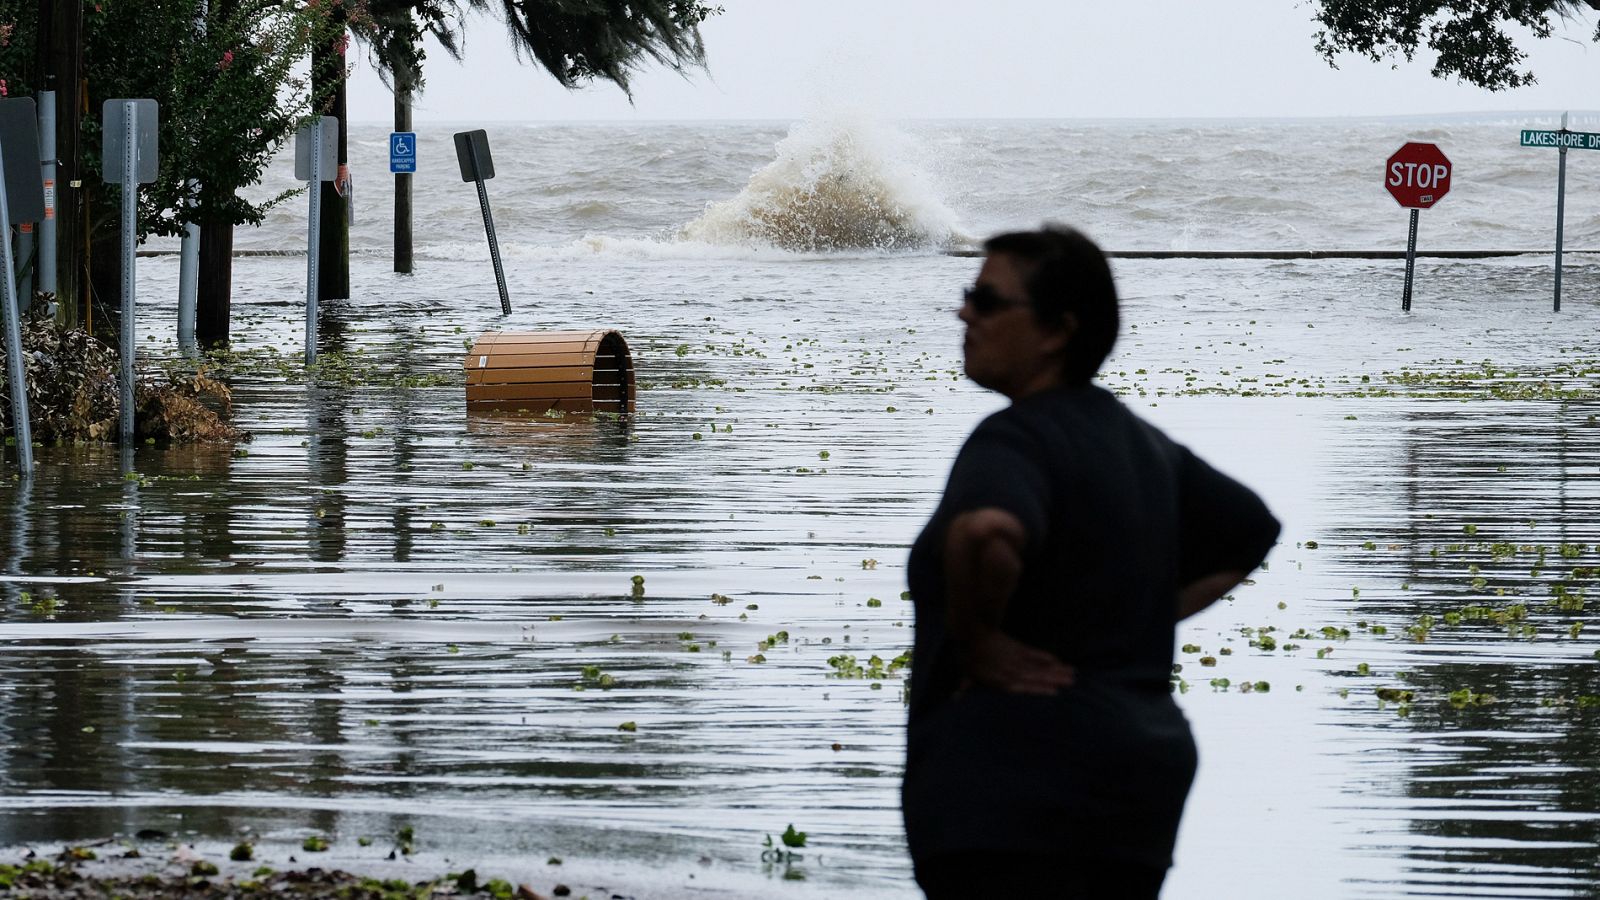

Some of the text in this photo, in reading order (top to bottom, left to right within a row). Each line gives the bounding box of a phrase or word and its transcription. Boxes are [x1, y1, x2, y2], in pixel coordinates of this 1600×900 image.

[1523, 132, 1600, 148] LAKESHORE DR
[1389, 162, 1448, 189] STOP
